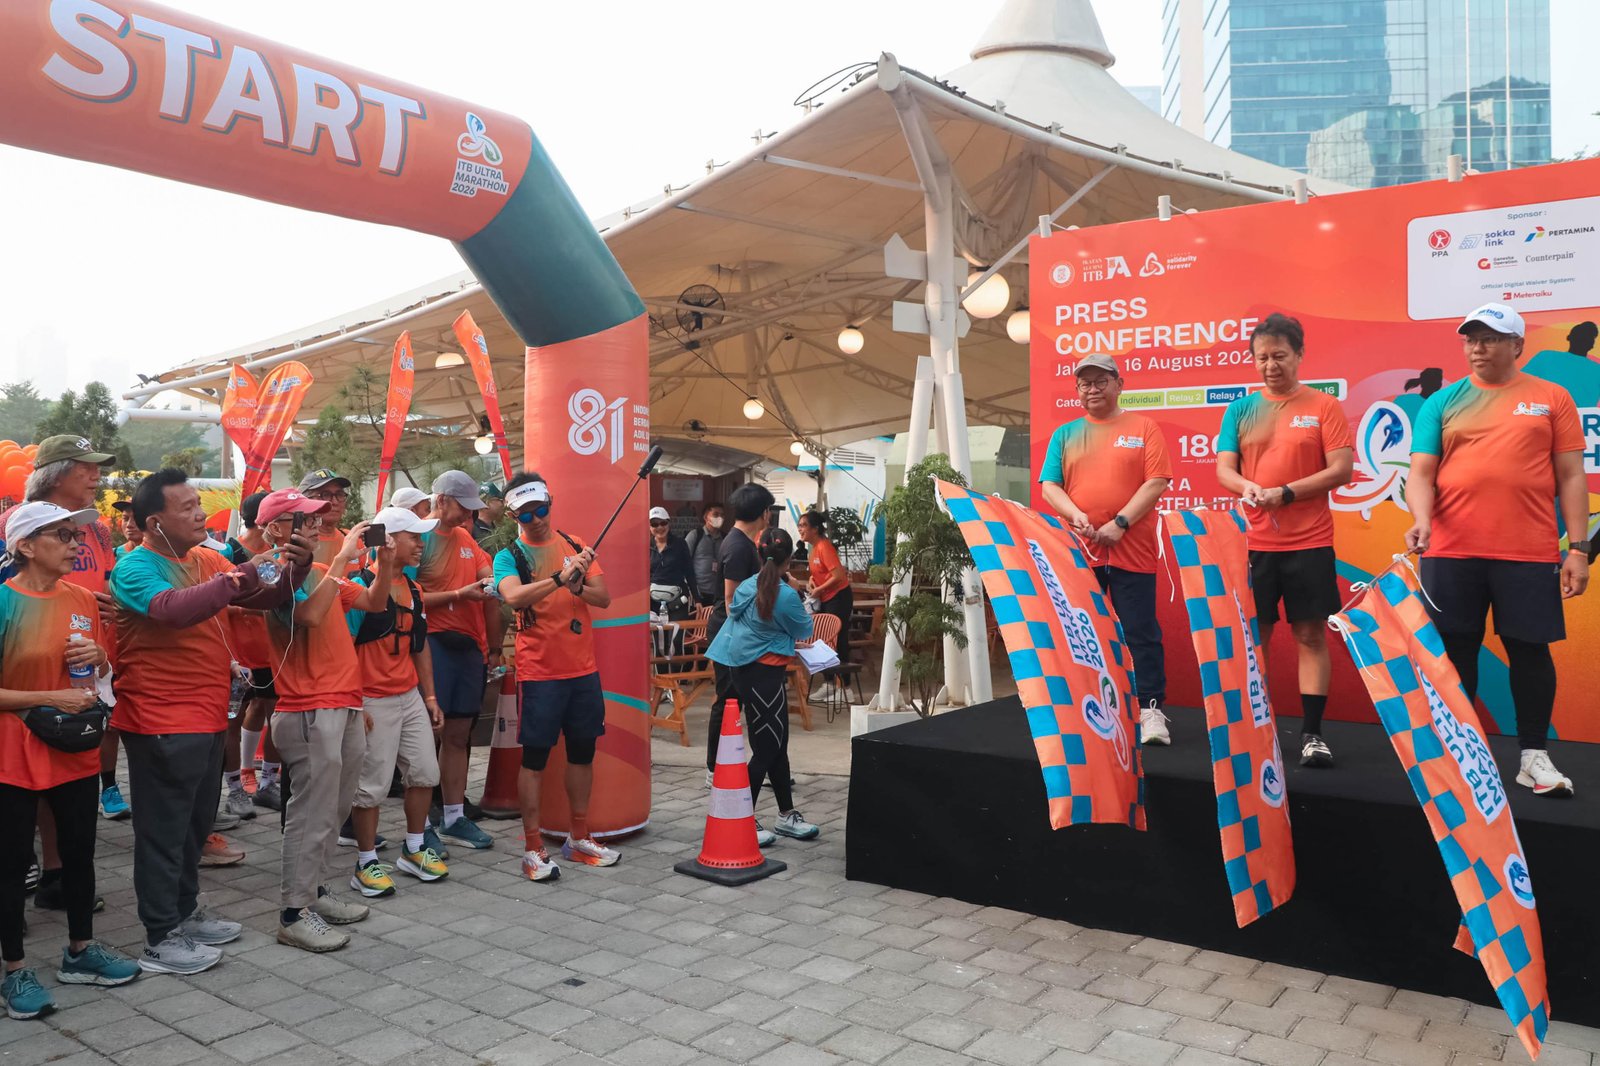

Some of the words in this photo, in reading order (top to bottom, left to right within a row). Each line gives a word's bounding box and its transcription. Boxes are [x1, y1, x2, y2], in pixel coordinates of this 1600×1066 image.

[41, 0, 425, 174] START
[458, 160, 473, 172] ITB
[475, 166, 502, 180] ULTRA
[452, 183, 475, 195] 2026
[455, 172, 507, 192] MARATHON
[1507, 211, 1542, 221] Sponsor
[1485, 229, 1516, 239] sokka
[1549, 226, 1595, 237] PERTAMINA
[1485, 239, 1504, 247] link
[1431, 250, 1449, 258] PPA
[1525, 251, 1575, 263] Counterpain
[1083, 270, 1103, 283] ITB
[1055, 297, 1148, 326] PRESS
[1055, 317, 1259, 356] CONFERENCE
[1125, 358, 1142, 372] 16
[1148, 352, 1212, 373] August
[1217, 350, 1254, 366] 202
[1120, 395, 1161, 406] Individual
[1169, 393, 1194, 405] Relay
[1195, 393, 1202, 402] 2
[1210, 391, 1235, 403] Relay
[1236, 391, 1244, 400] 4
[1324, 386, 1335, 395] 16
[567, 388, 629, 464] 81
[1076, 612, 1104, 669] 2026
[1250, 679, 1262, 722] ITB
[1466, 768, 1495, 817] ITB
